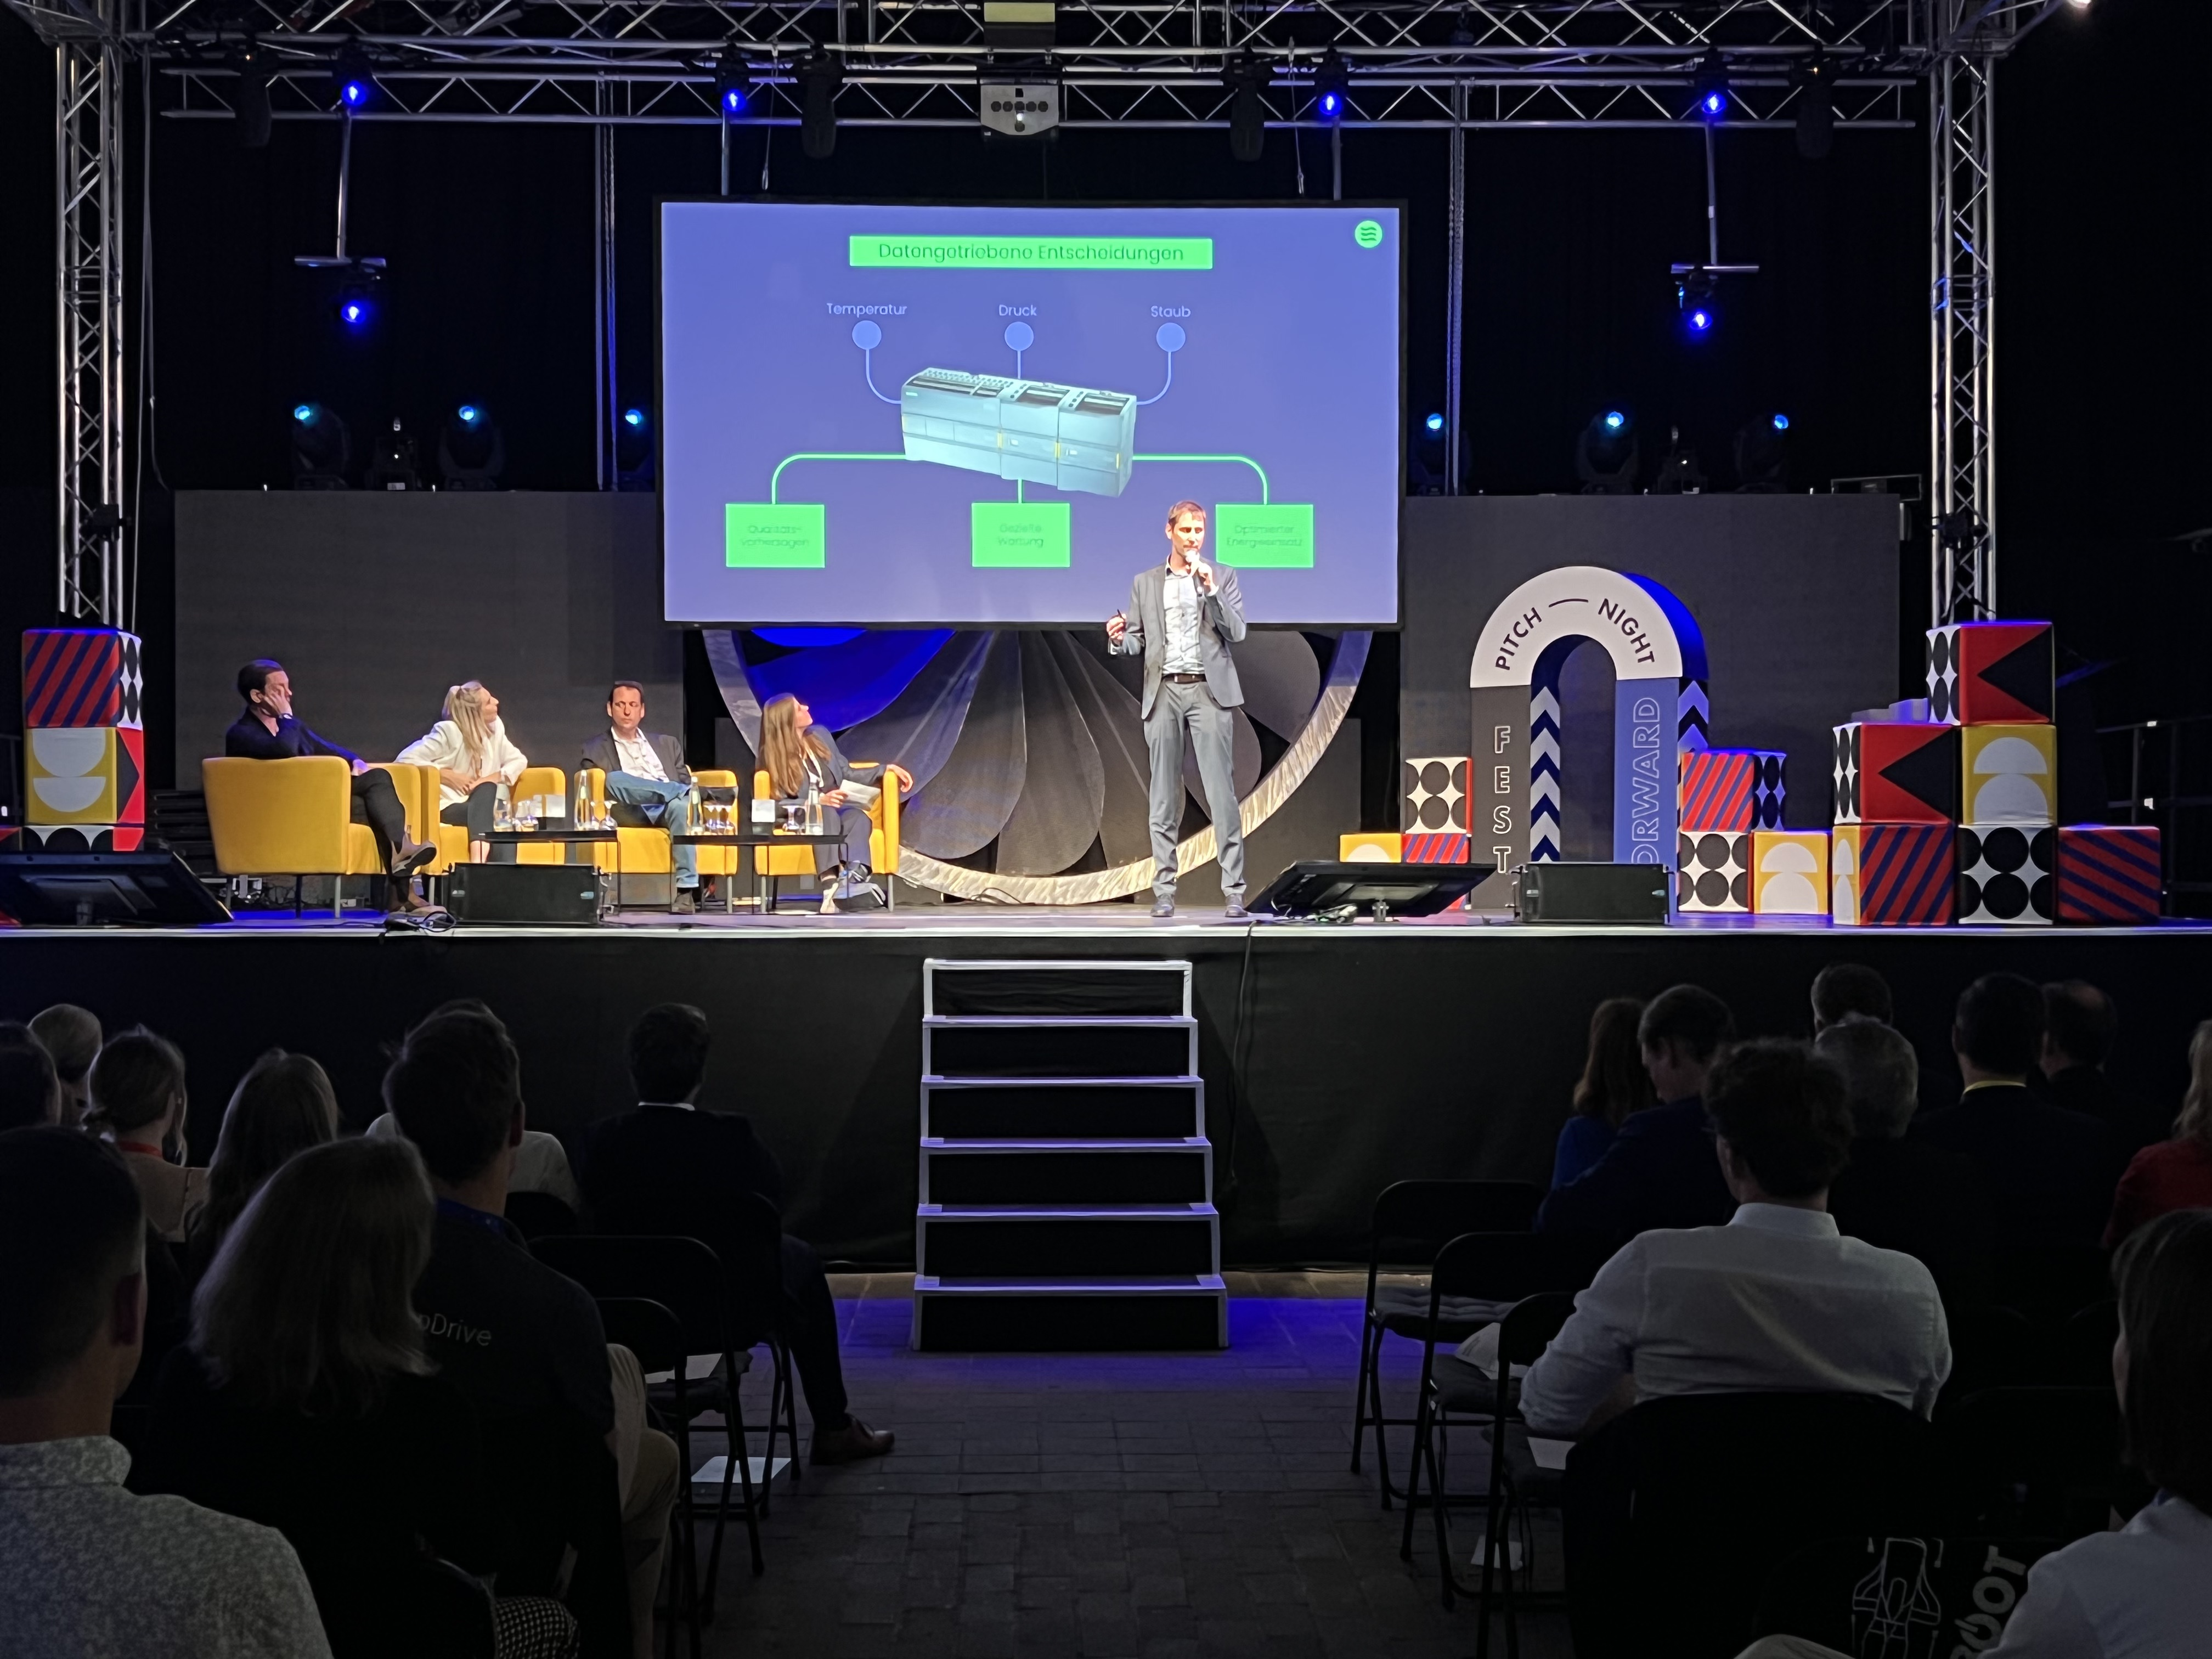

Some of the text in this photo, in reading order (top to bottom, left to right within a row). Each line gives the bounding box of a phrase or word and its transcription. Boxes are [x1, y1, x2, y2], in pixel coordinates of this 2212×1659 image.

[879, 244, 1184, 265] Datengetriebene Entscheidungen
[826, 303, 908, 318] Temperatur
[998, 304, 1037, 317] Druck
[1150, 305, 1192, 318] Staub
[1495, 598, 1655, 671] PITCH NIGHT
[1492, 725, 1512, 874] FEST
